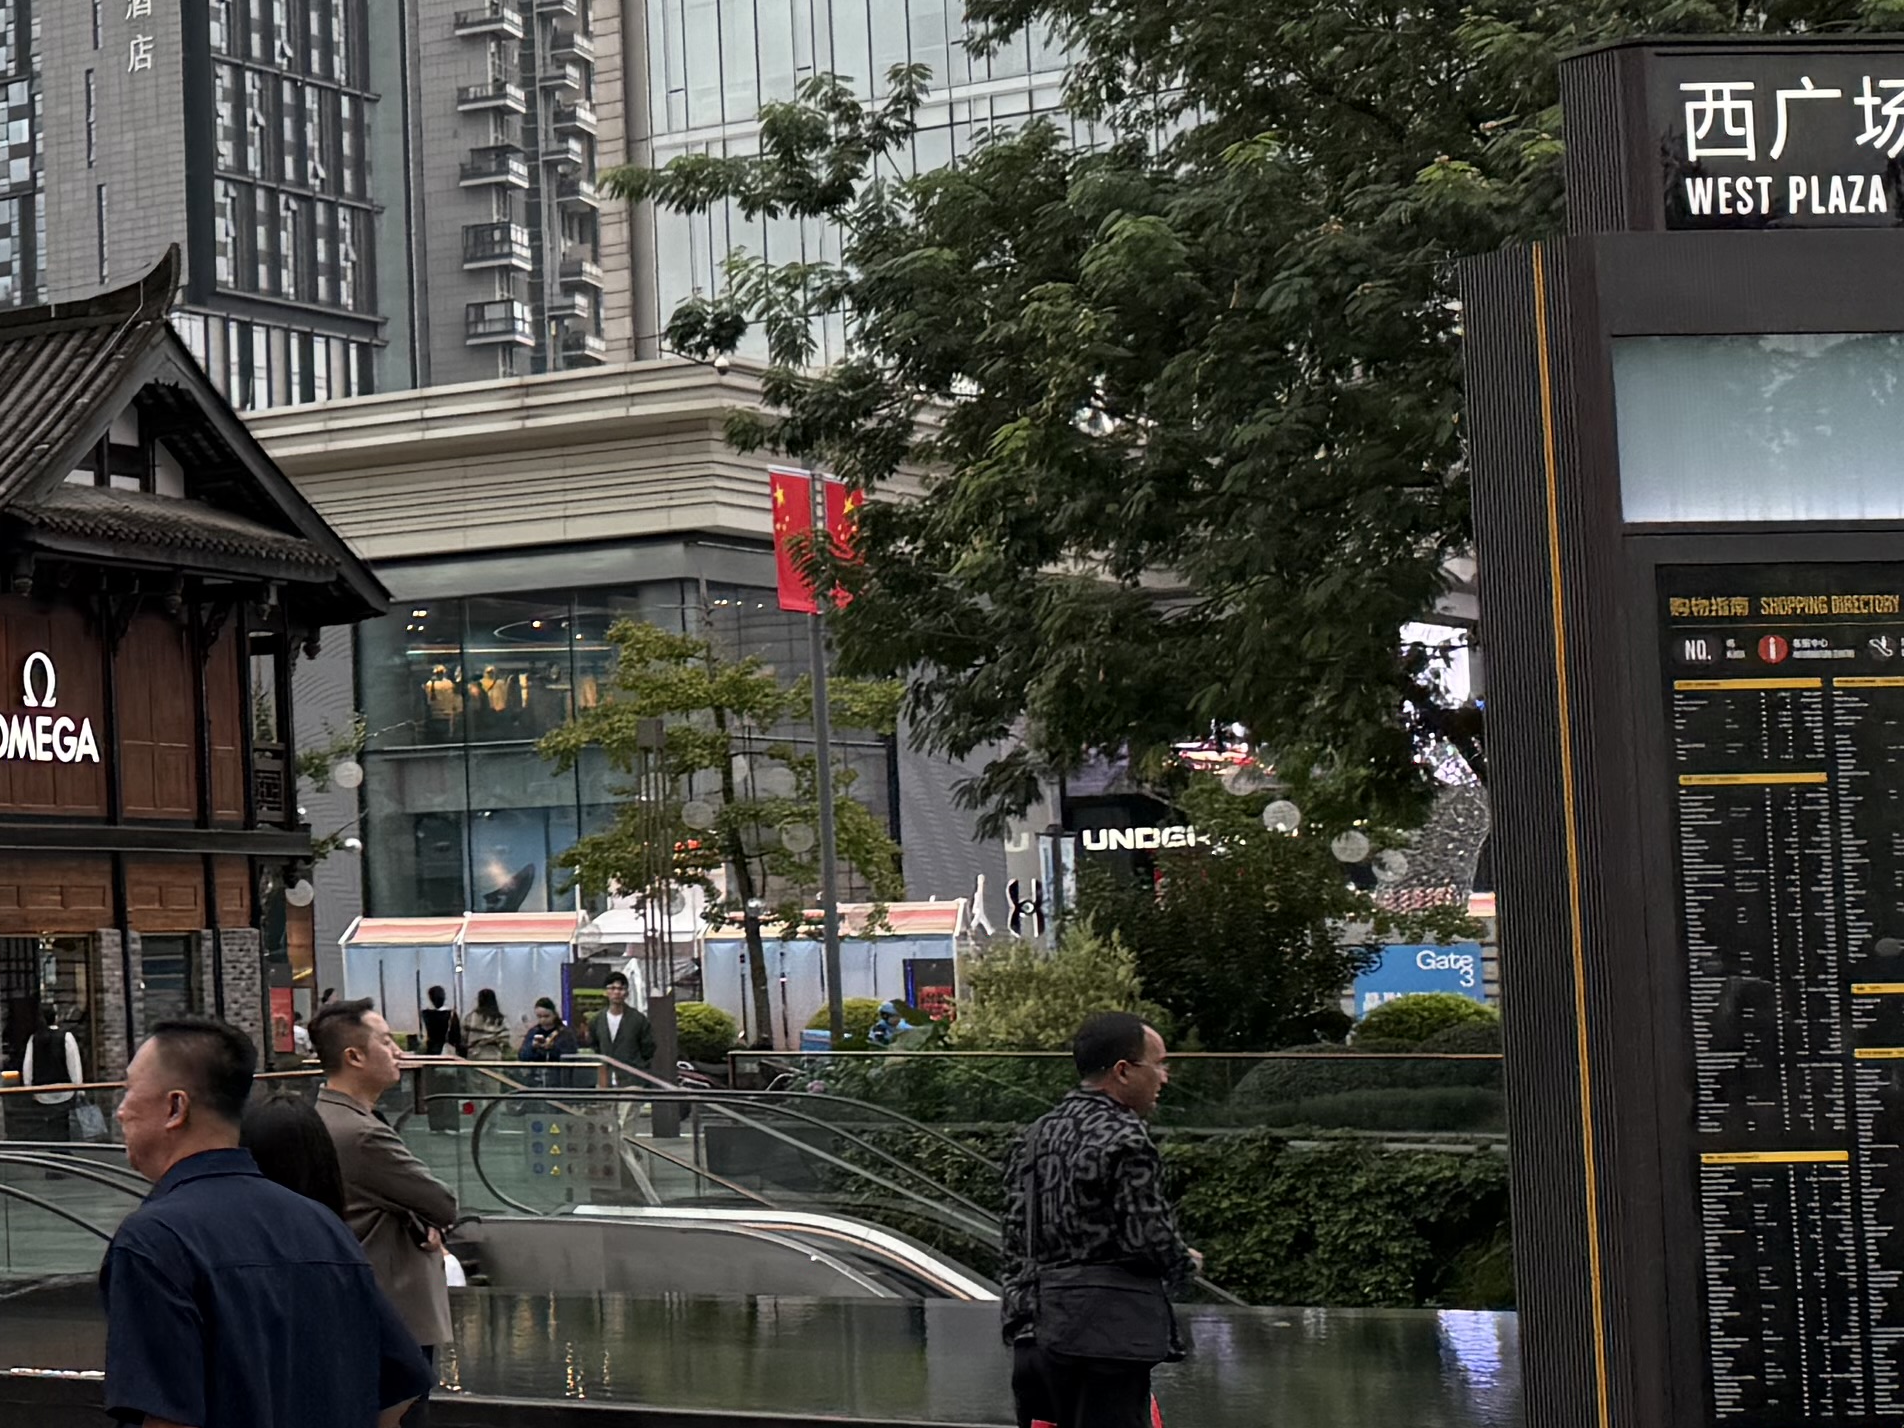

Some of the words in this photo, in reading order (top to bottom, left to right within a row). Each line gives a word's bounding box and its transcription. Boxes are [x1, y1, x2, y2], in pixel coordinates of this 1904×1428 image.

[1679, 75, 1904, 162] 西广场
[1685, 175, 1773, 215] WEST
[1788, 174, 1888, 215] PLAZA
[1760, 595, 1828, 615] SHOPPING
[1831, 594, 1900, 614] DIRECTORY
[1416, 949, 1474, 971] Gate
[1459, 968, 1475, 988] 3
